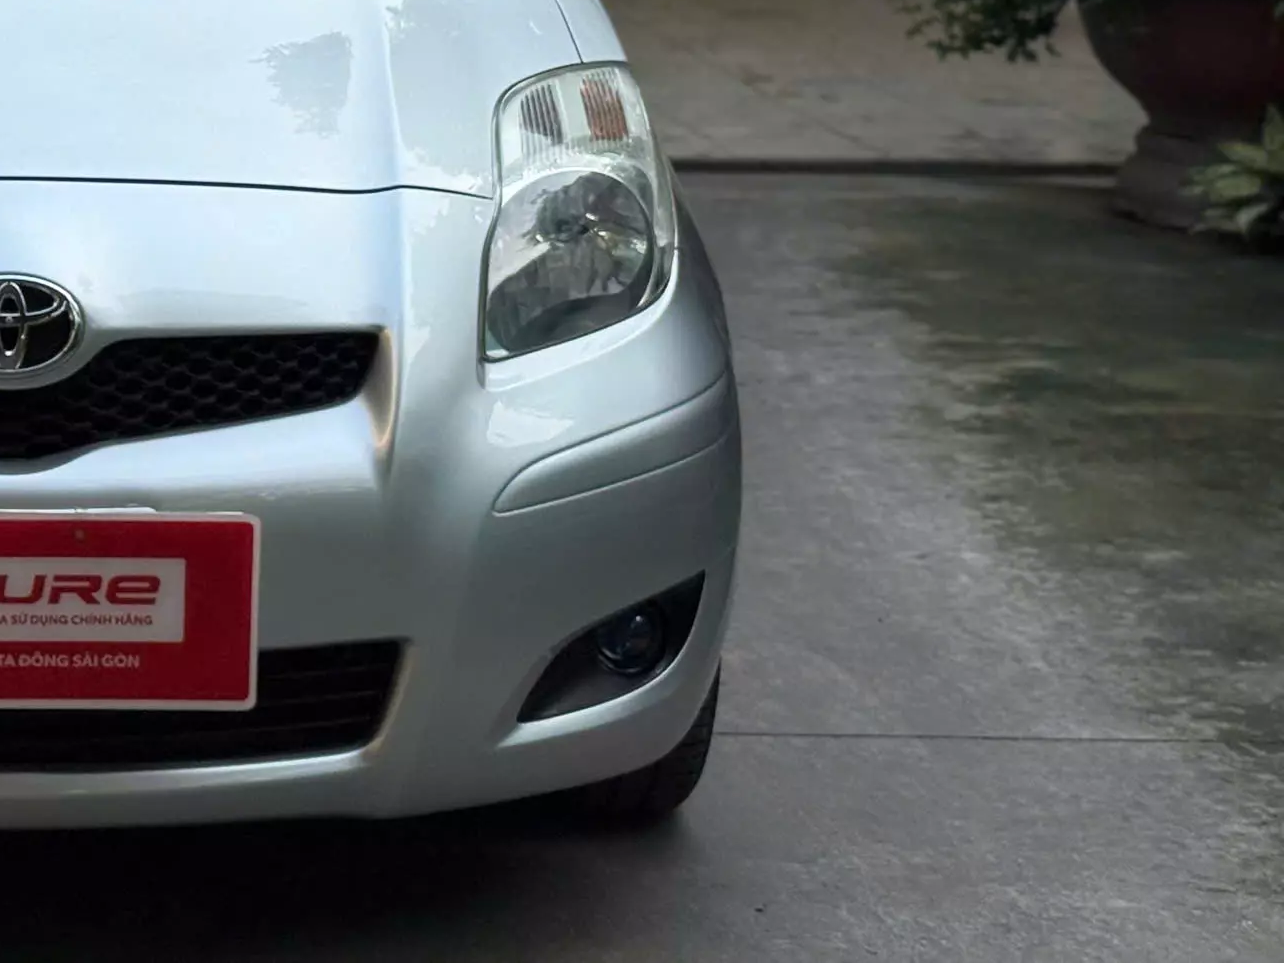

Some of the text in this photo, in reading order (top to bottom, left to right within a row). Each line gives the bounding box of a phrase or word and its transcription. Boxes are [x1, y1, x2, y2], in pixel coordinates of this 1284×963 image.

[70, 611, 112, 625] CHÍNH
[18, 650, 69, 668] ĐÔNG
[72, 651, 99, 669] SÀI
[102, 652, 140, 670] GÒN
